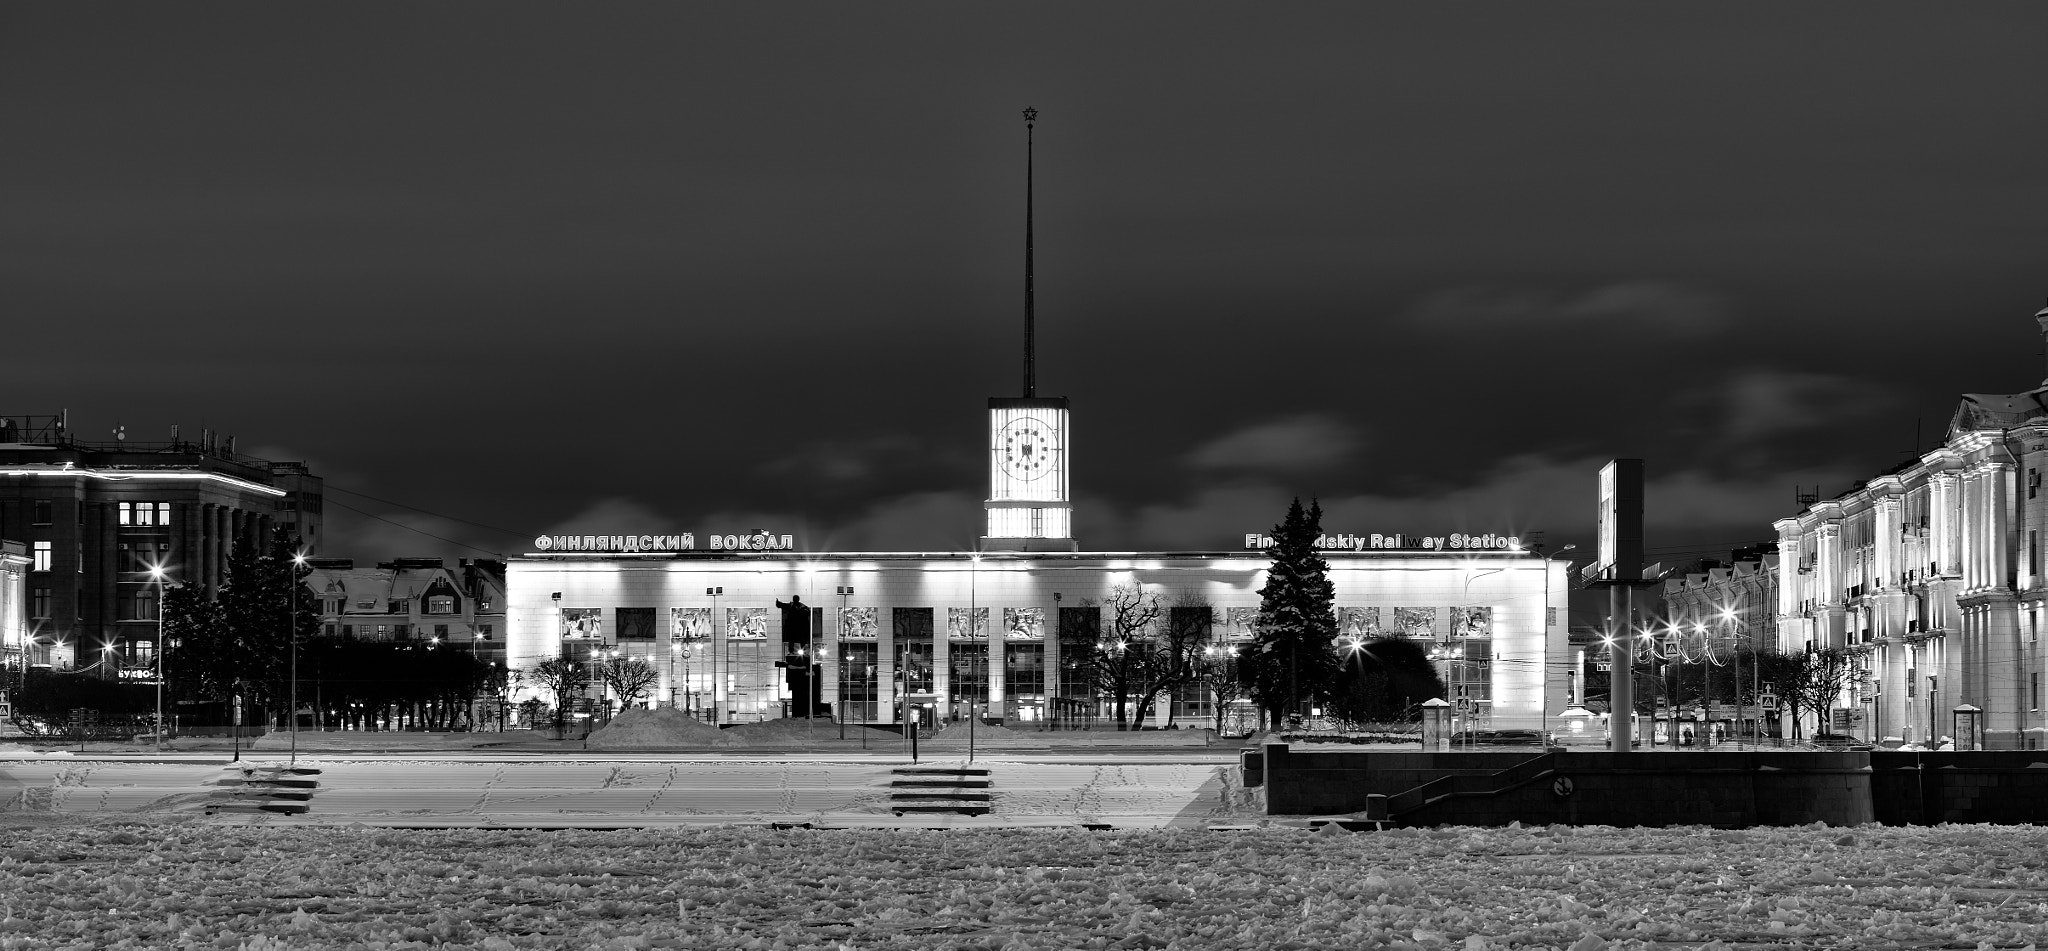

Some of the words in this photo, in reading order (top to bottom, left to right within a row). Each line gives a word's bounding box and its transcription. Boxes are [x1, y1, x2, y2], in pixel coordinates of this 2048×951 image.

[534, 533, 695, 552] ФИНЛЯНДСКИЙ
[710, 534, 793, 550] ВОКЗАЛ
[1245, 533, 1366, 551] Findskiy
[1370, 533, 1445, 551] Railway
[1449, 533, 1520, 549] Station
